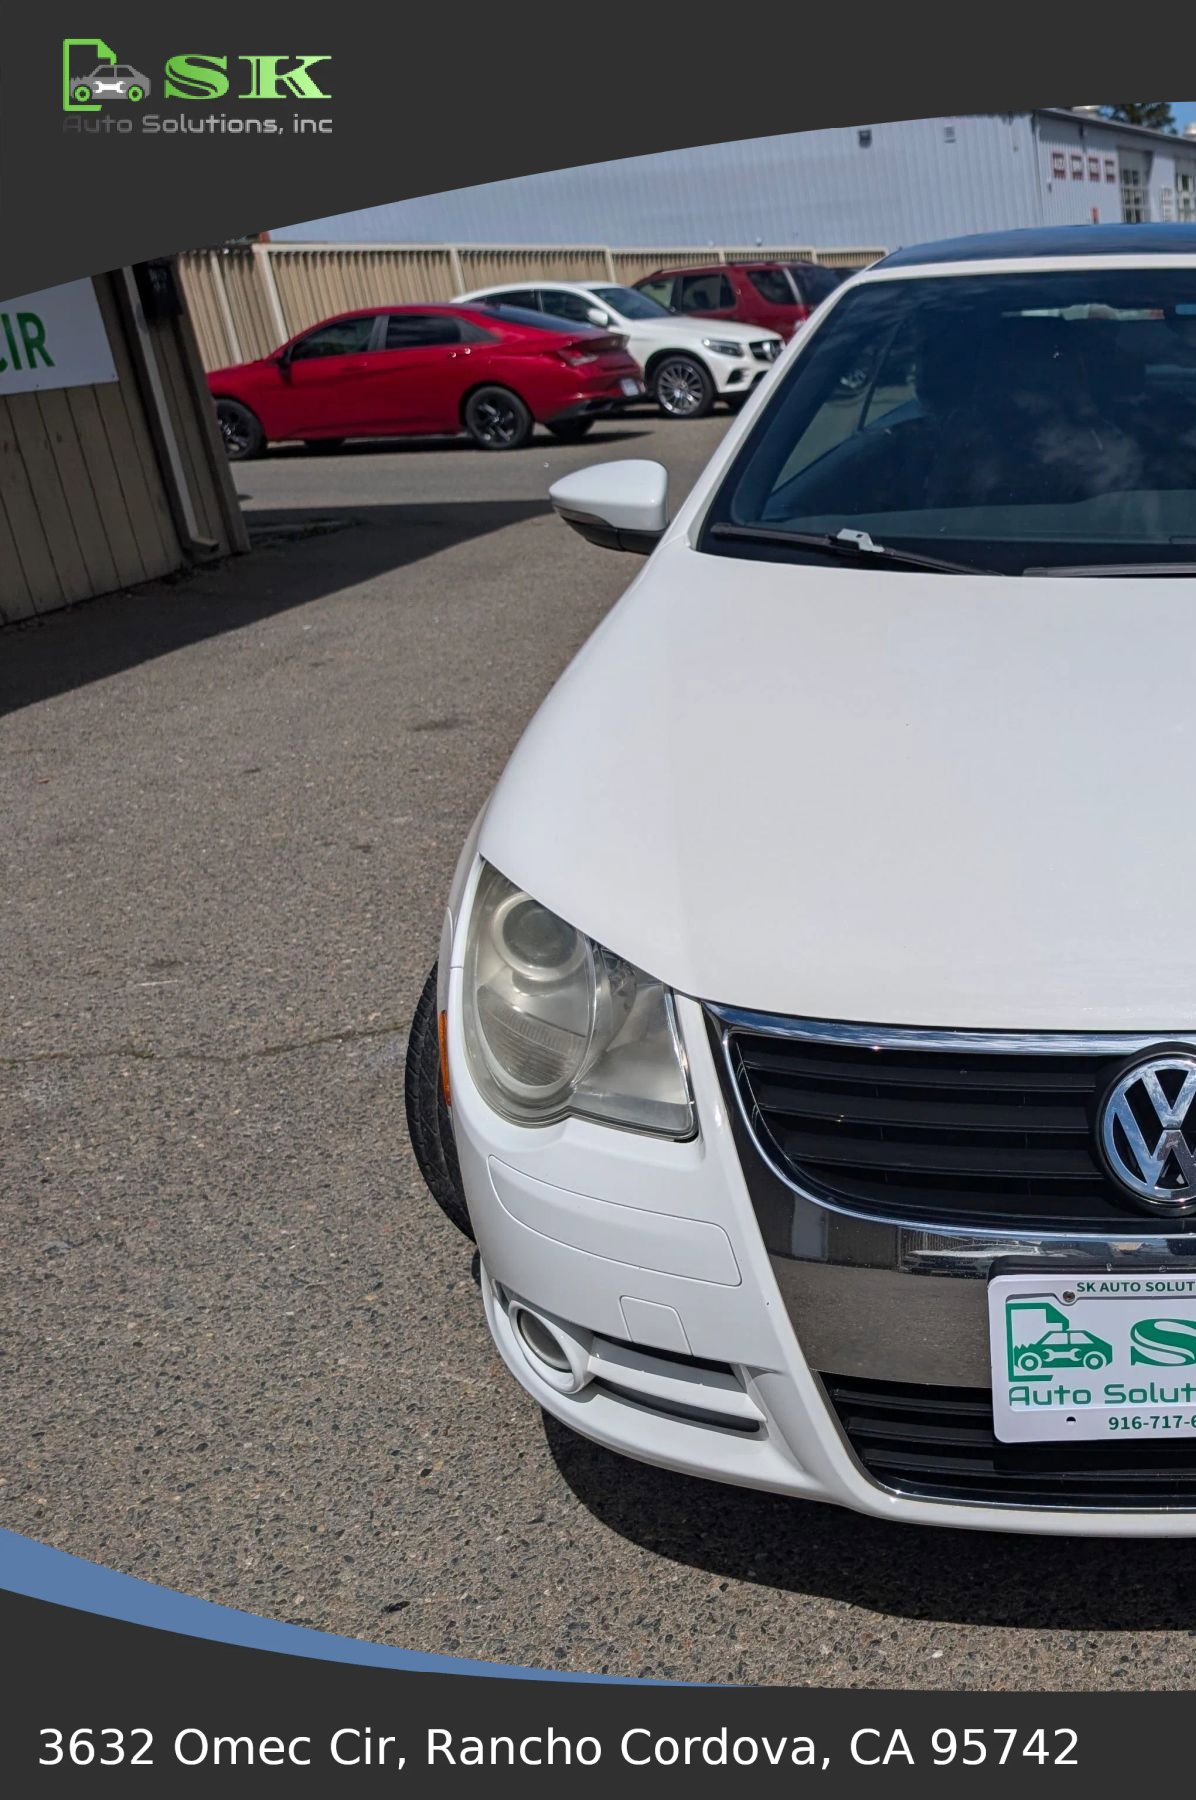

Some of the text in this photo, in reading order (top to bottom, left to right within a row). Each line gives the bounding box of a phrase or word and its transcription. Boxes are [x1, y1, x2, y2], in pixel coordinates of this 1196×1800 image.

[1076, 1281, 1096, 1293] SK
[1100, 1281, 1141, 1293] AUTO
[1009, 1384, 1092, 1406] Auto
